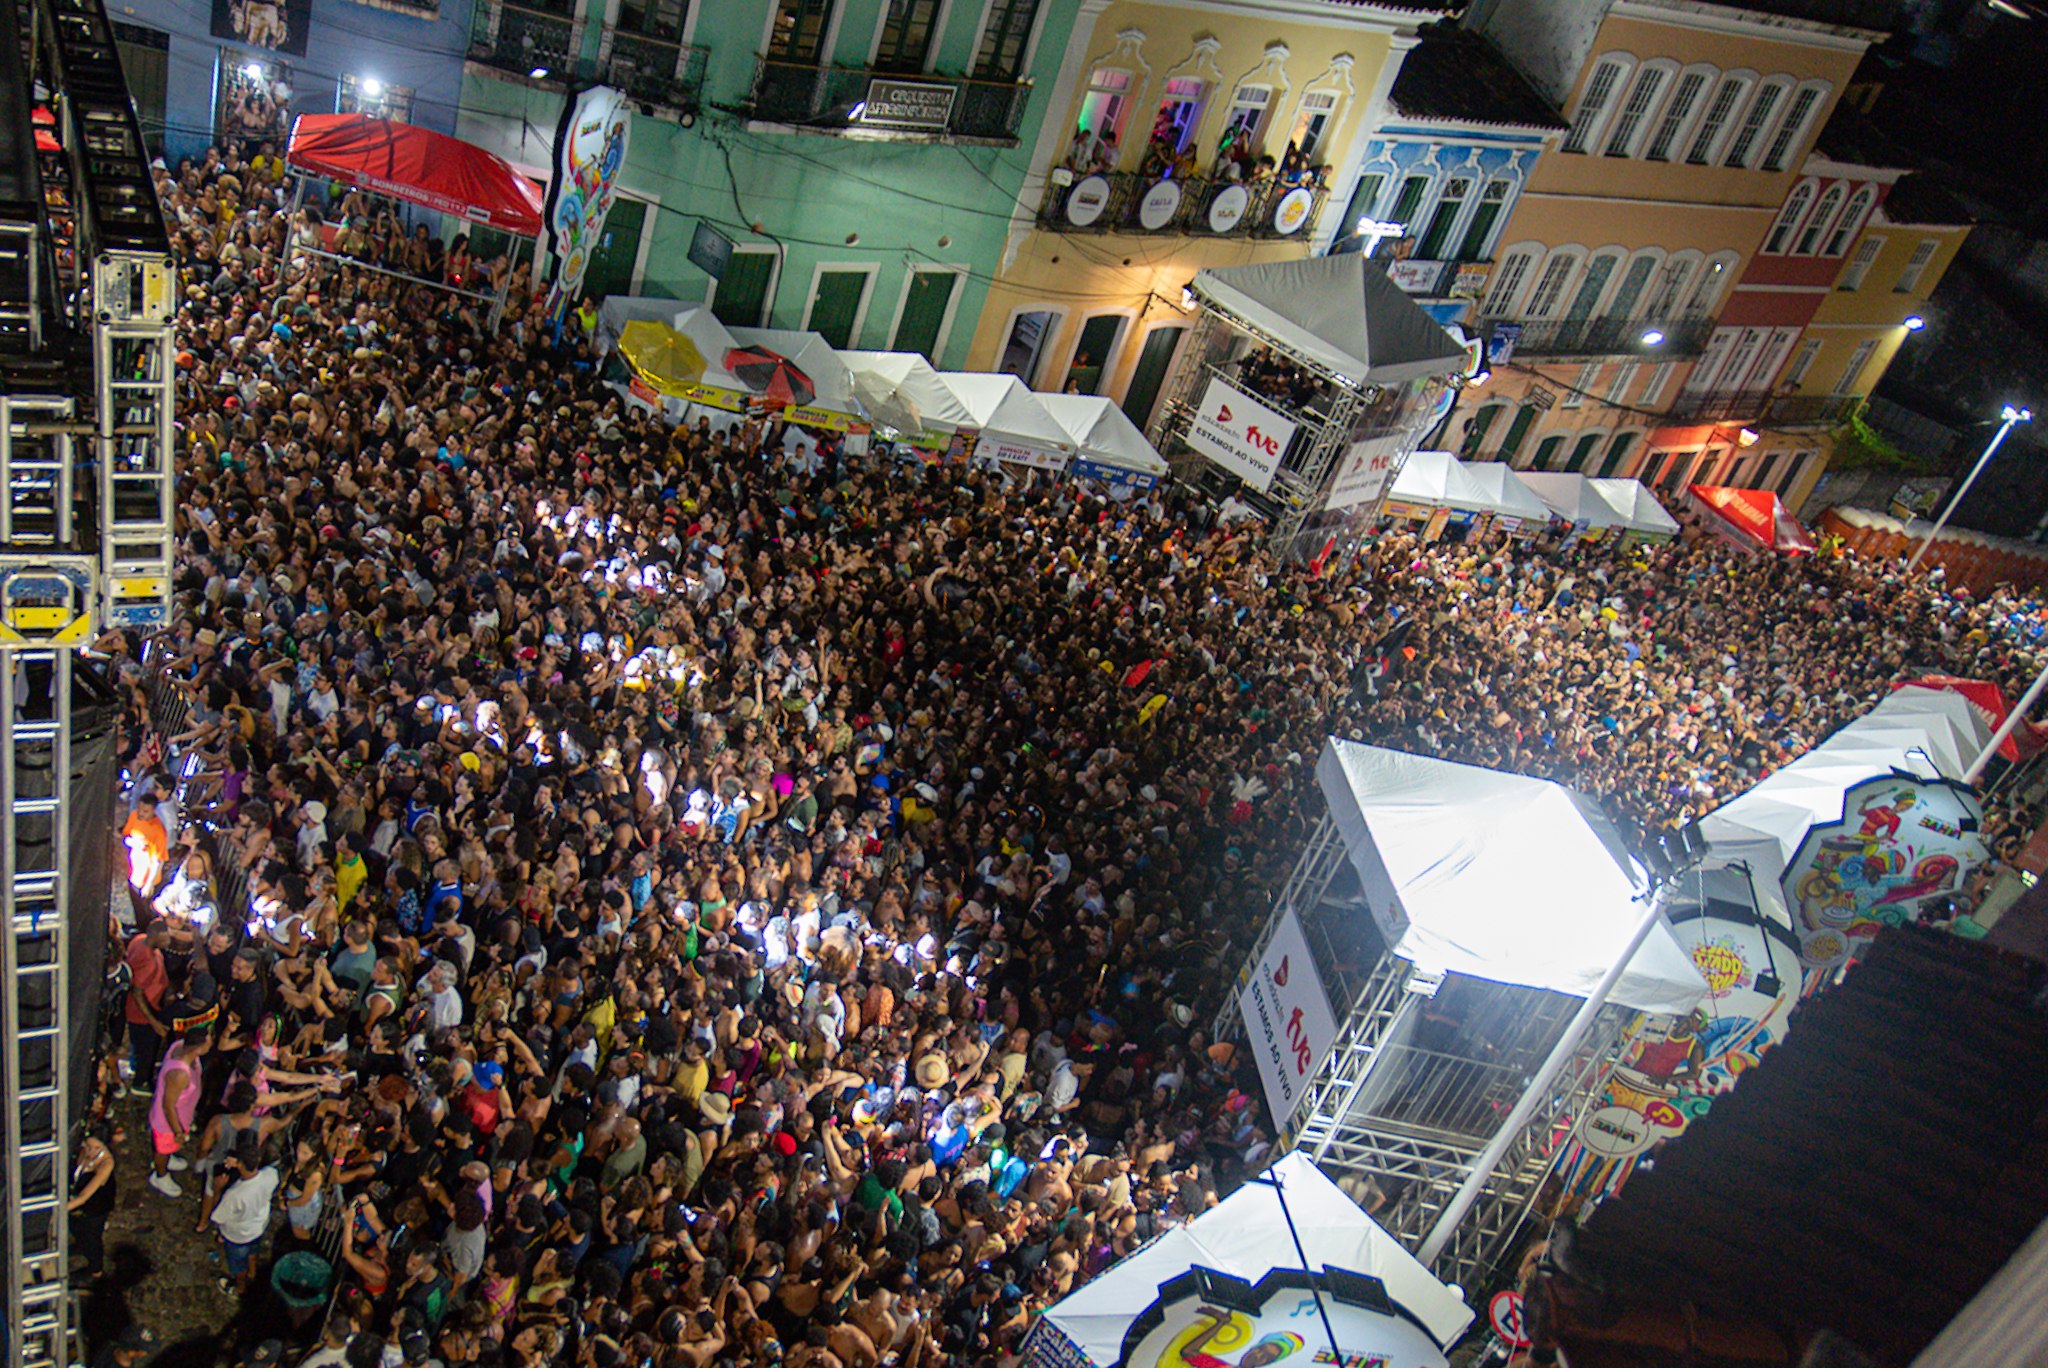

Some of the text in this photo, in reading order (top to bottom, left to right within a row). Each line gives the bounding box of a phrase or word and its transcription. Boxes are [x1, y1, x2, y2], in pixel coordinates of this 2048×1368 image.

[371, 178, 429, 202] BOMBEIROS
[1196, 427, 1269, 473] ESTAMOS AO VIVO
[1251, 980, 1292, 1101] ESTAMOS AO VIVO
